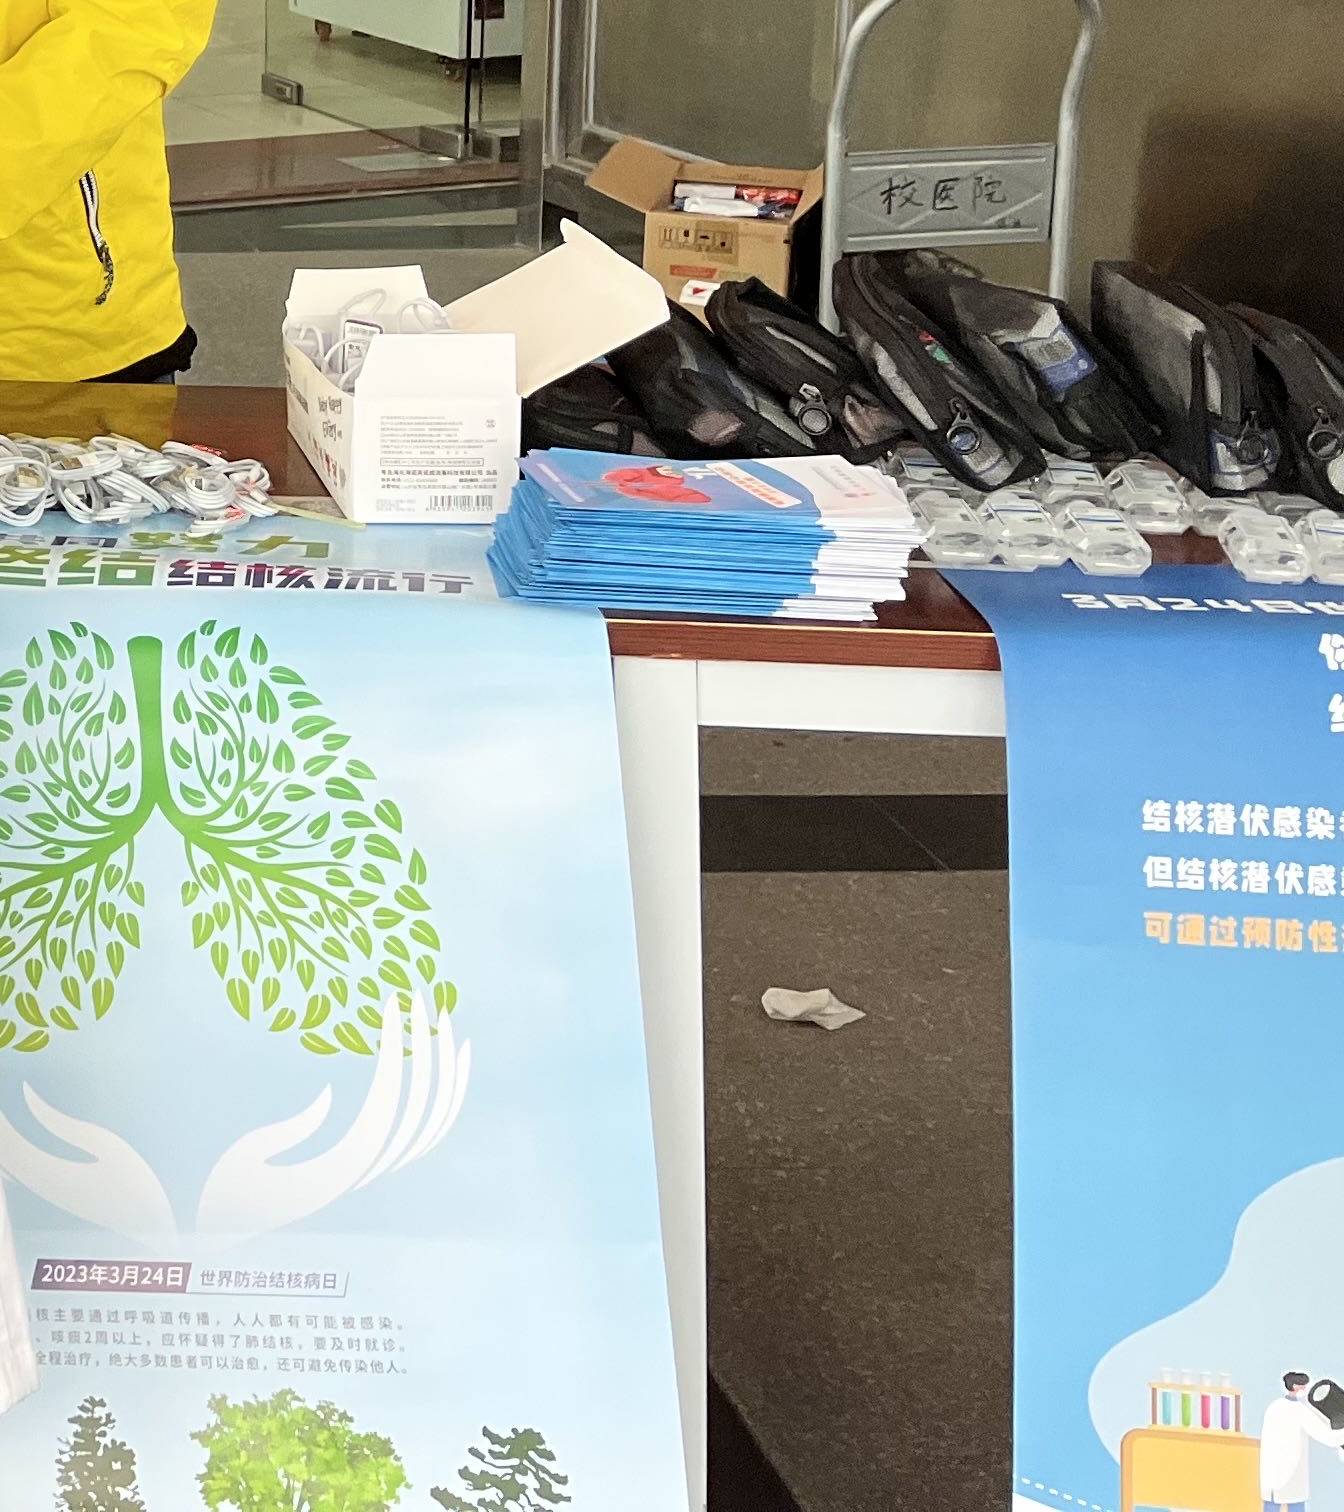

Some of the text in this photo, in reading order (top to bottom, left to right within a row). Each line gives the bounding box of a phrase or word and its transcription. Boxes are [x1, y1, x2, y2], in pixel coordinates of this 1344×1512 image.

[880, 175, 1007, 215] 校医院
[1141, 799, 1344, 840] 结核潜伏感染
[1143, 855, 1344, 897] 但结核潜伏感
[1143, 911, 1344, 953] 可通过预防性
[40, 1263, 338, 1291] 2023年3月24日 世界防治结核病日
[29, 1307, 404, 1331] 核主要通过呼吸道传播，人人都有可能被感染。
